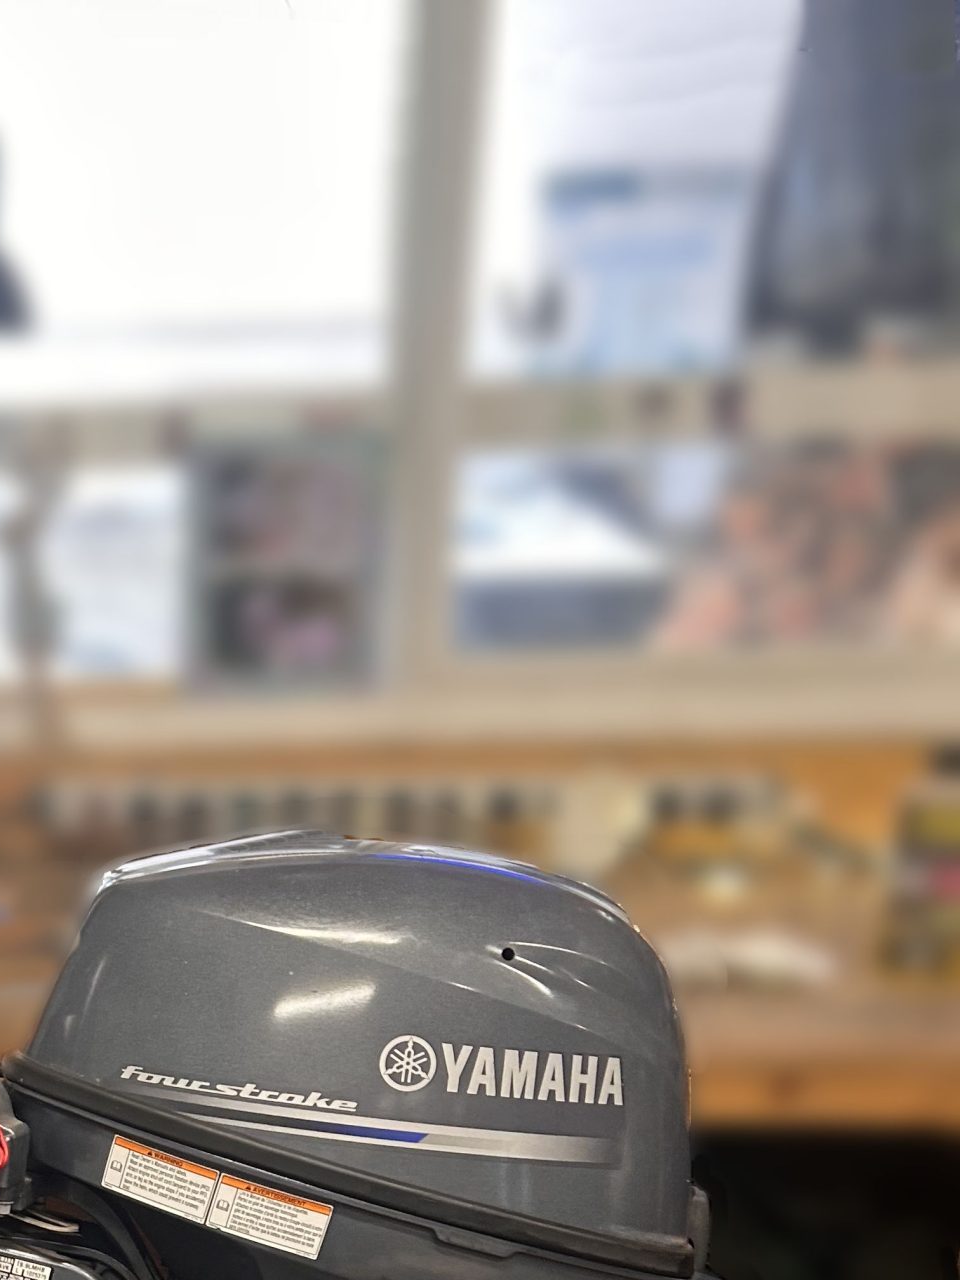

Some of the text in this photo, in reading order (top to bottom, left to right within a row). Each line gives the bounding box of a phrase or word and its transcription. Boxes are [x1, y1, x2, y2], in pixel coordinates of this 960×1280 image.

[441, 1042, 624, 1106] YAMAHA
[153, 1152, 183, 1168] WARNING
[252, 1185, 307, 1207] AVERTISSEMENT
